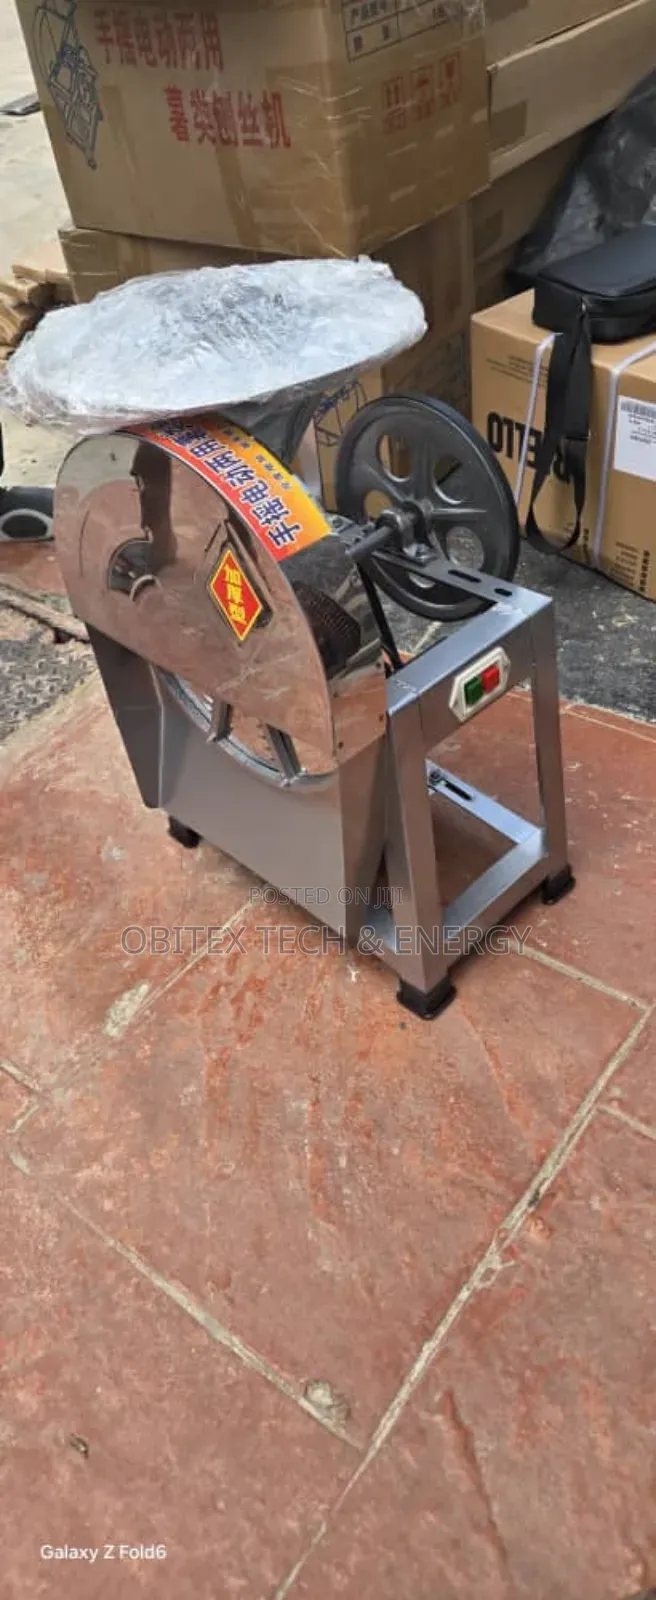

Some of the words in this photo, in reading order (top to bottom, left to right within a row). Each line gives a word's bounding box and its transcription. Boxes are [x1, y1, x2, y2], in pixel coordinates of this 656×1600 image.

[93, 8, 224, 72] 手摇电动两用
[223, 564, 248, 626] 加厚型
